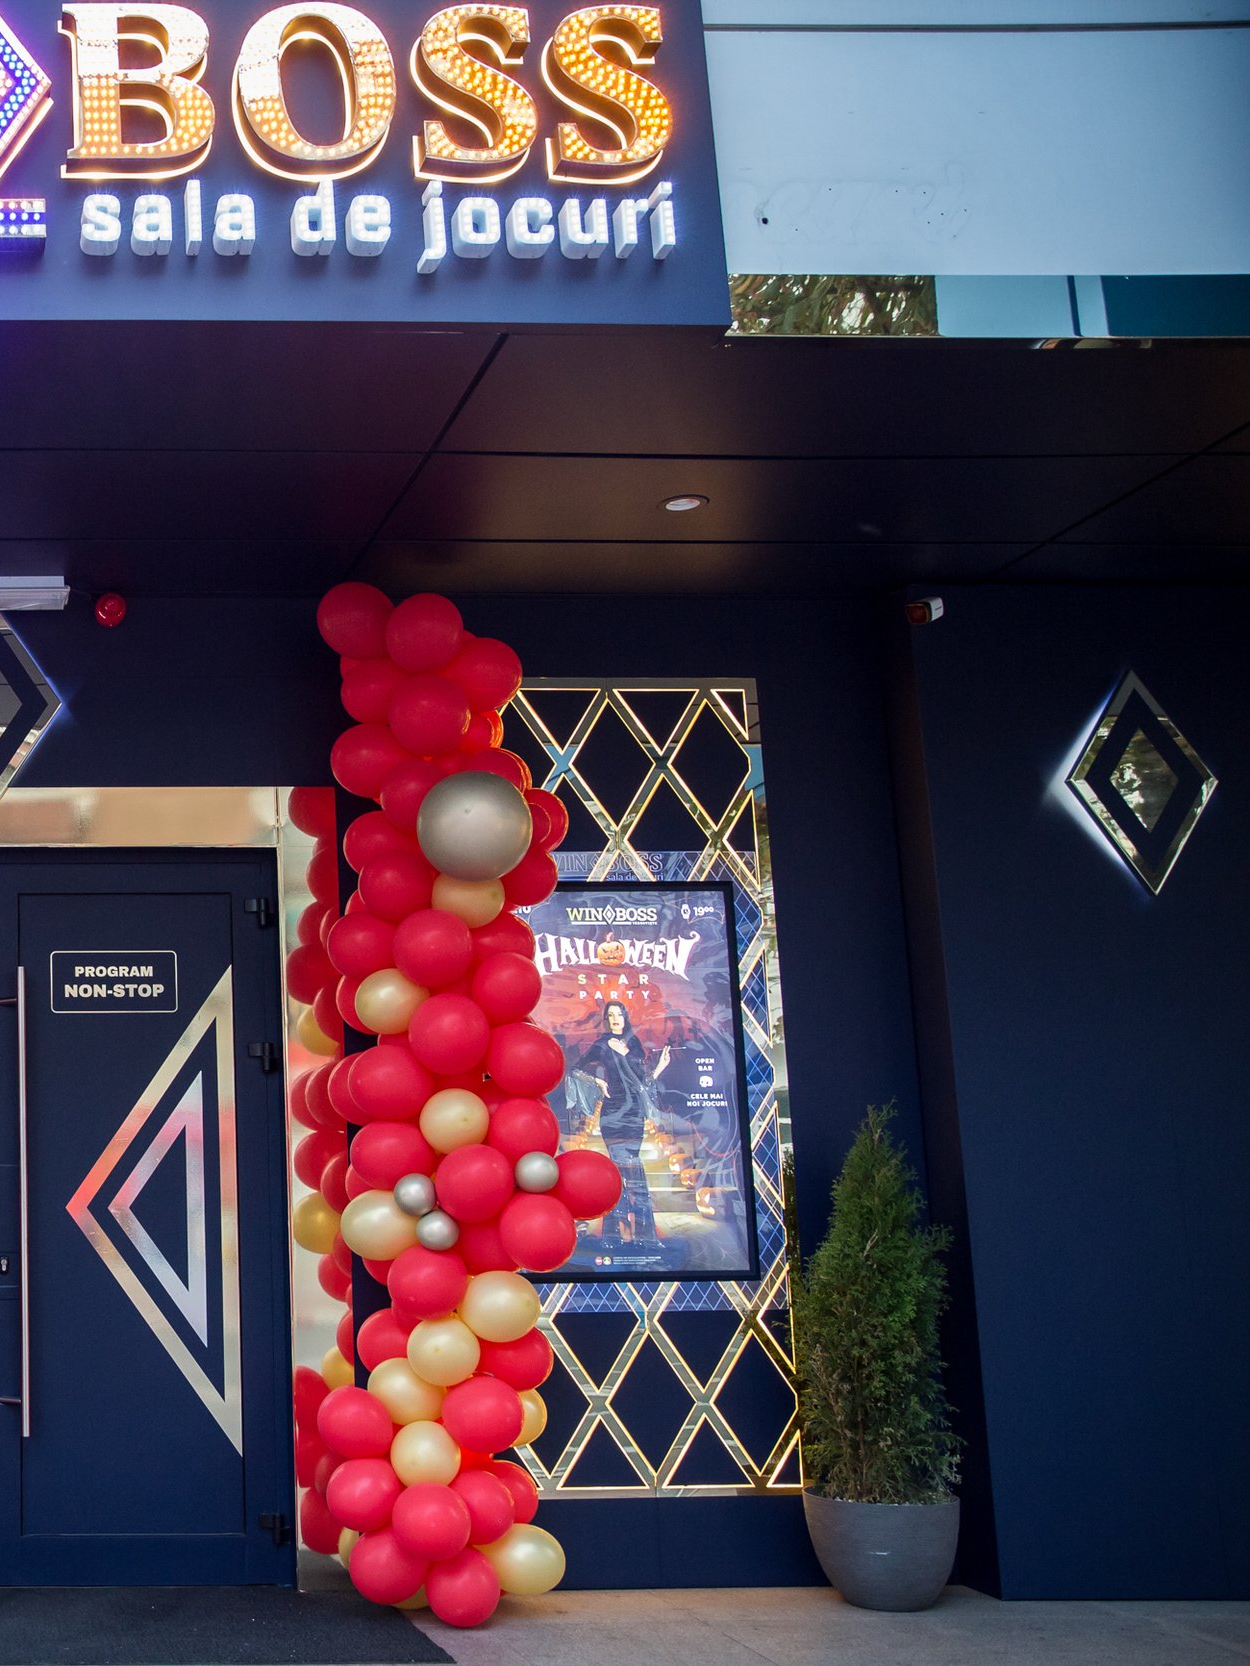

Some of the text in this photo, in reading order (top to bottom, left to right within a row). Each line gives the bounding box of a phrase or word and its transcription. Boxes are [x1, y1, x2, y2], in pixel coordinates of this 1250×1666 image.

[58, 1, 672, 183] BOSS
[80, 180, 677, 274] sala de jocuri
[606, 873, 624, 881] sala
[566, 907, 658, 921] WIN BOSS
[74, 965, 154, 978] PROGRAM
[577, 974, 650, 985] STAR
[64, 984, 165, 998] NON-STOP
[579, 990, 651, 1000] PARTY
